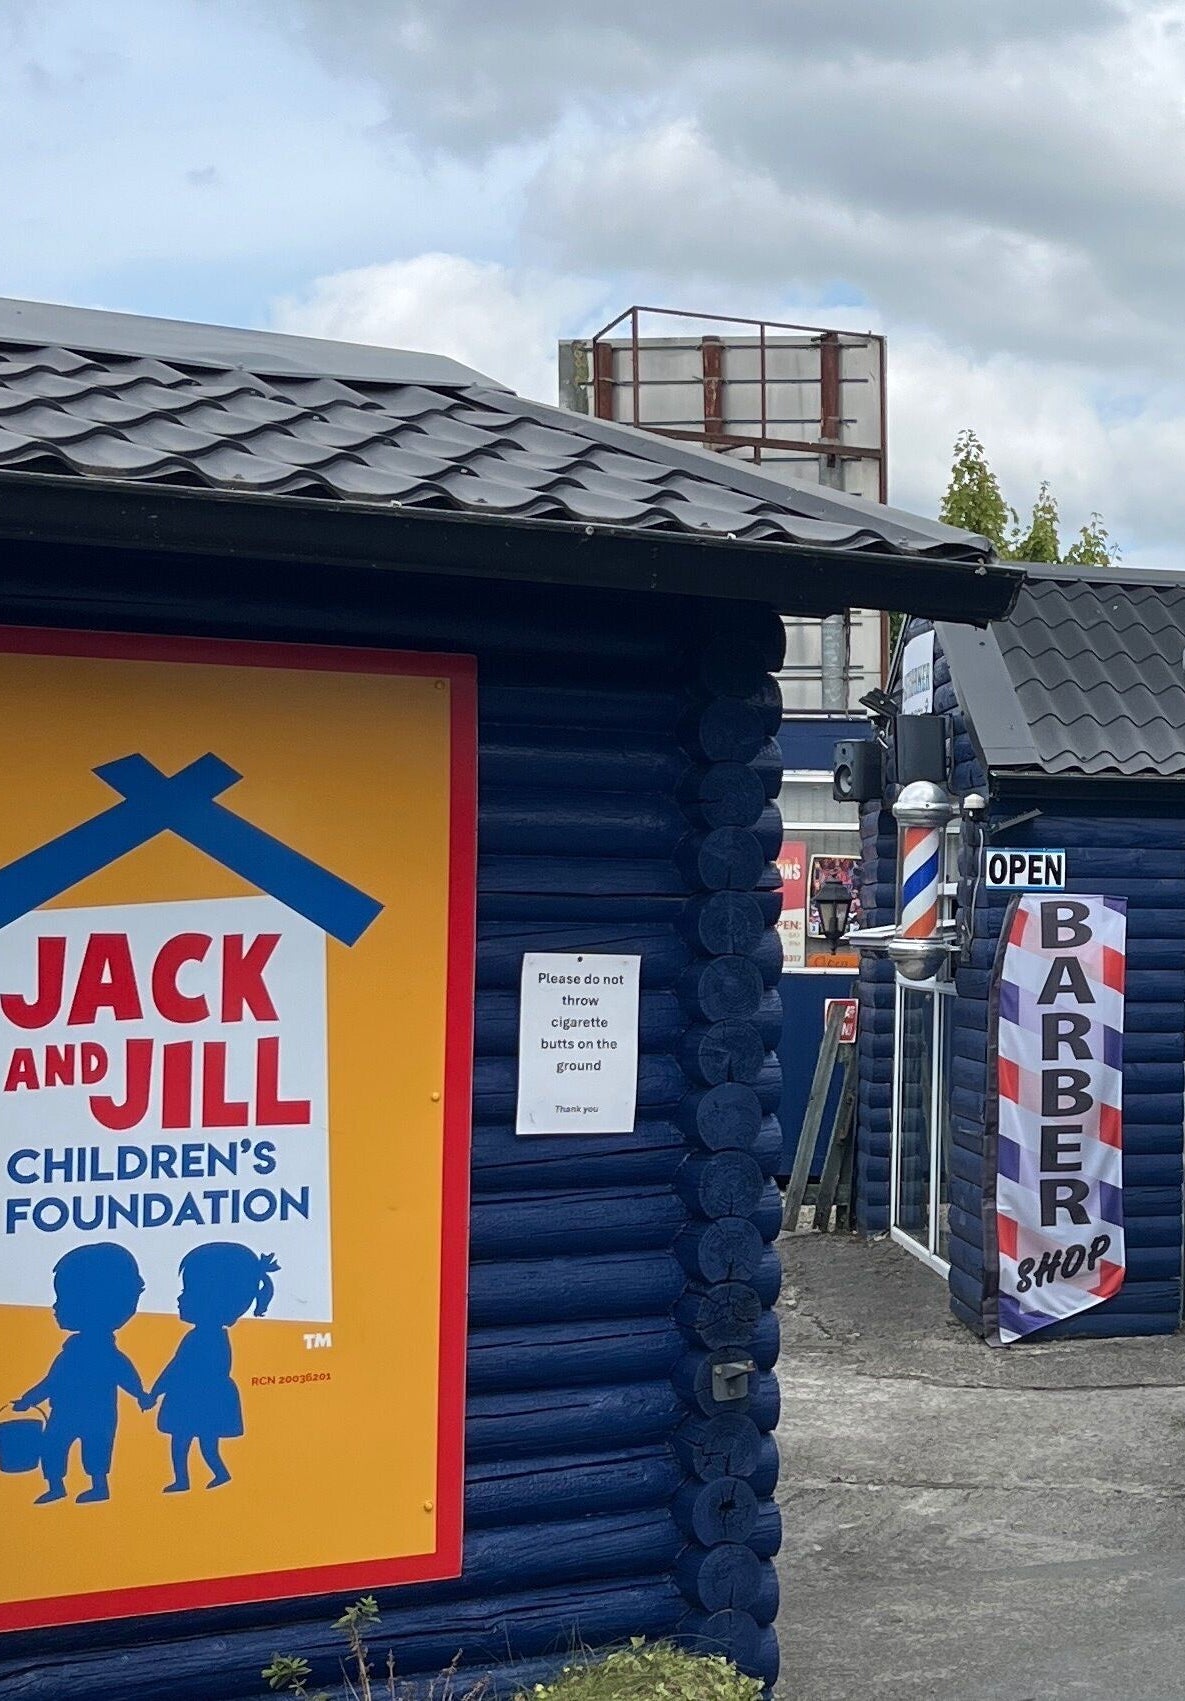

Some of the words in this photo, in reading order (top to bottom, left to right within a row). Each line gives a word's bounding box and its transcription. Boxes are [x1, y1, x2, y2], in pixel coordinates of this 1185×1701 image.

[988, 853, 1063, 886] OPEN
[0, 933, 282, 1030] JACK
[538, 973, 581, 985] Please
[584, 973, 600, 985] do
[603, 974, 624, 985] not
[562, 995, 599, 1006] throw
[551, 1016, 608, 1030] cigarette
[541, 1038, 575, 1049] butts
[578, 1040, 593, 1049] on
[597, 1038, 618, 1050] the
[556, 1060, 601, 1073] ground
[1037, 900, 1096, 1228] BARBER
[4, 1042, 109, 1092] AND
[89, 1036, 311, 1130] JILL
[555, 1105, 581, 1113] Thank
[583, 1106, 599, 1115] you
[7, 1138, 277, 1184] CHILDREN'S
[5, 1186, 310, 1234] FOUNDATION
[1016, 1234, 1111, 1293] SHOP
[303, 1333, 332, 1350] TM
[251, 1376, 275, 1387] RCN
